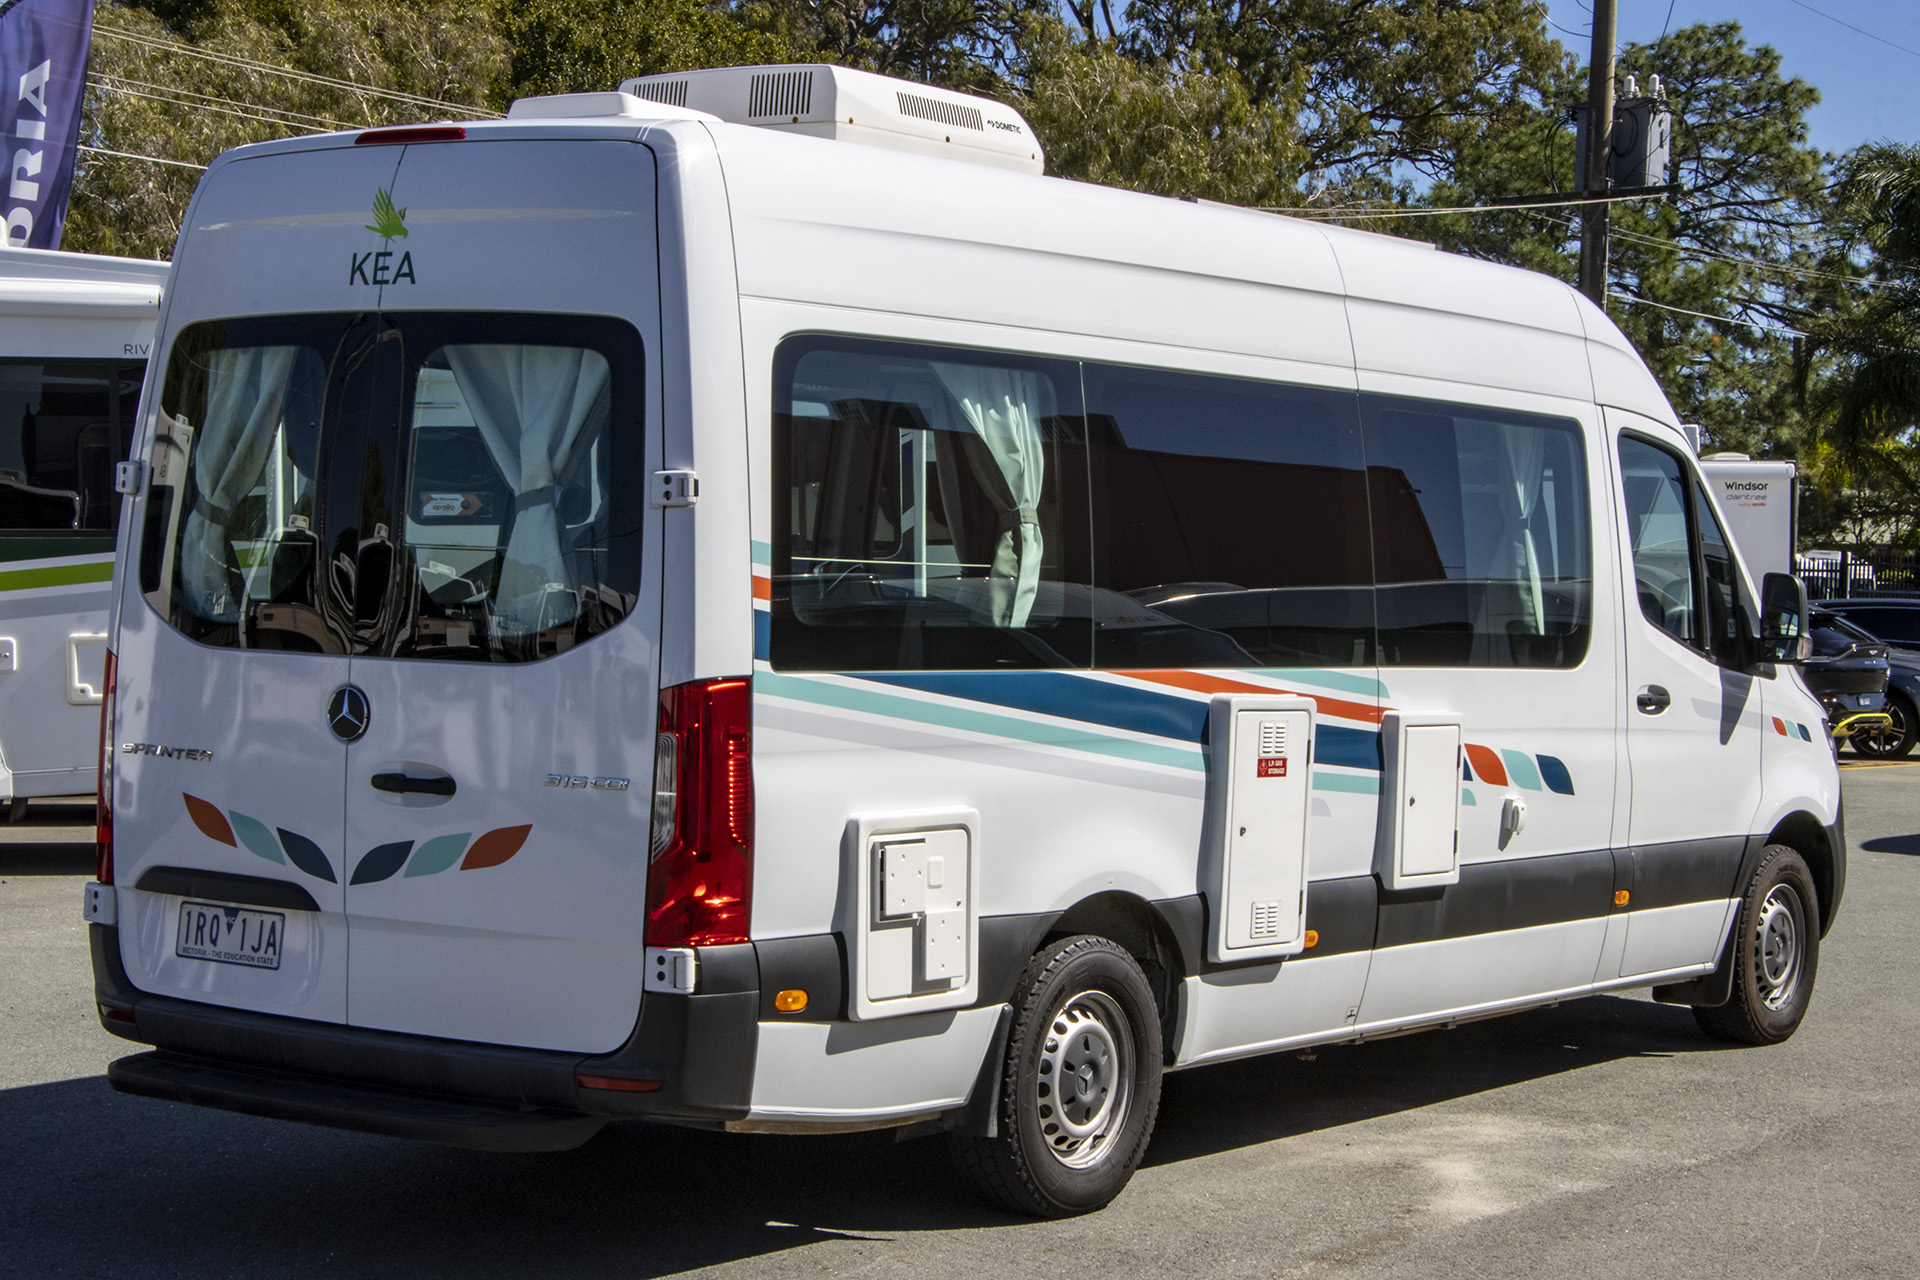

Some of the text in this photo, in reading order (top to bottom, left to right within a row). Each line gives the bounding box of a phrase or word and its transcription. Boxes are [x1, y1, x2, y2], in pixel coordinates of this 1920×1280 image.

[995, 121, 1021, 134] DOMETIC
[349, 251, 416, 286] KEA
[1725, 481, 1768, 491] Windsor
[122, 742, 213, 761] SPRINTER
[544, 773, 630, 791] 316 CDI
[184, 910, 277, 956] 1RQ 1JA
[182, 946, 207, 956] VICTORIA
[212, 950, 222, 959] THE
[223, 951, 256, 963] EDUCATION
[256, 956, 274, 966] STATE
